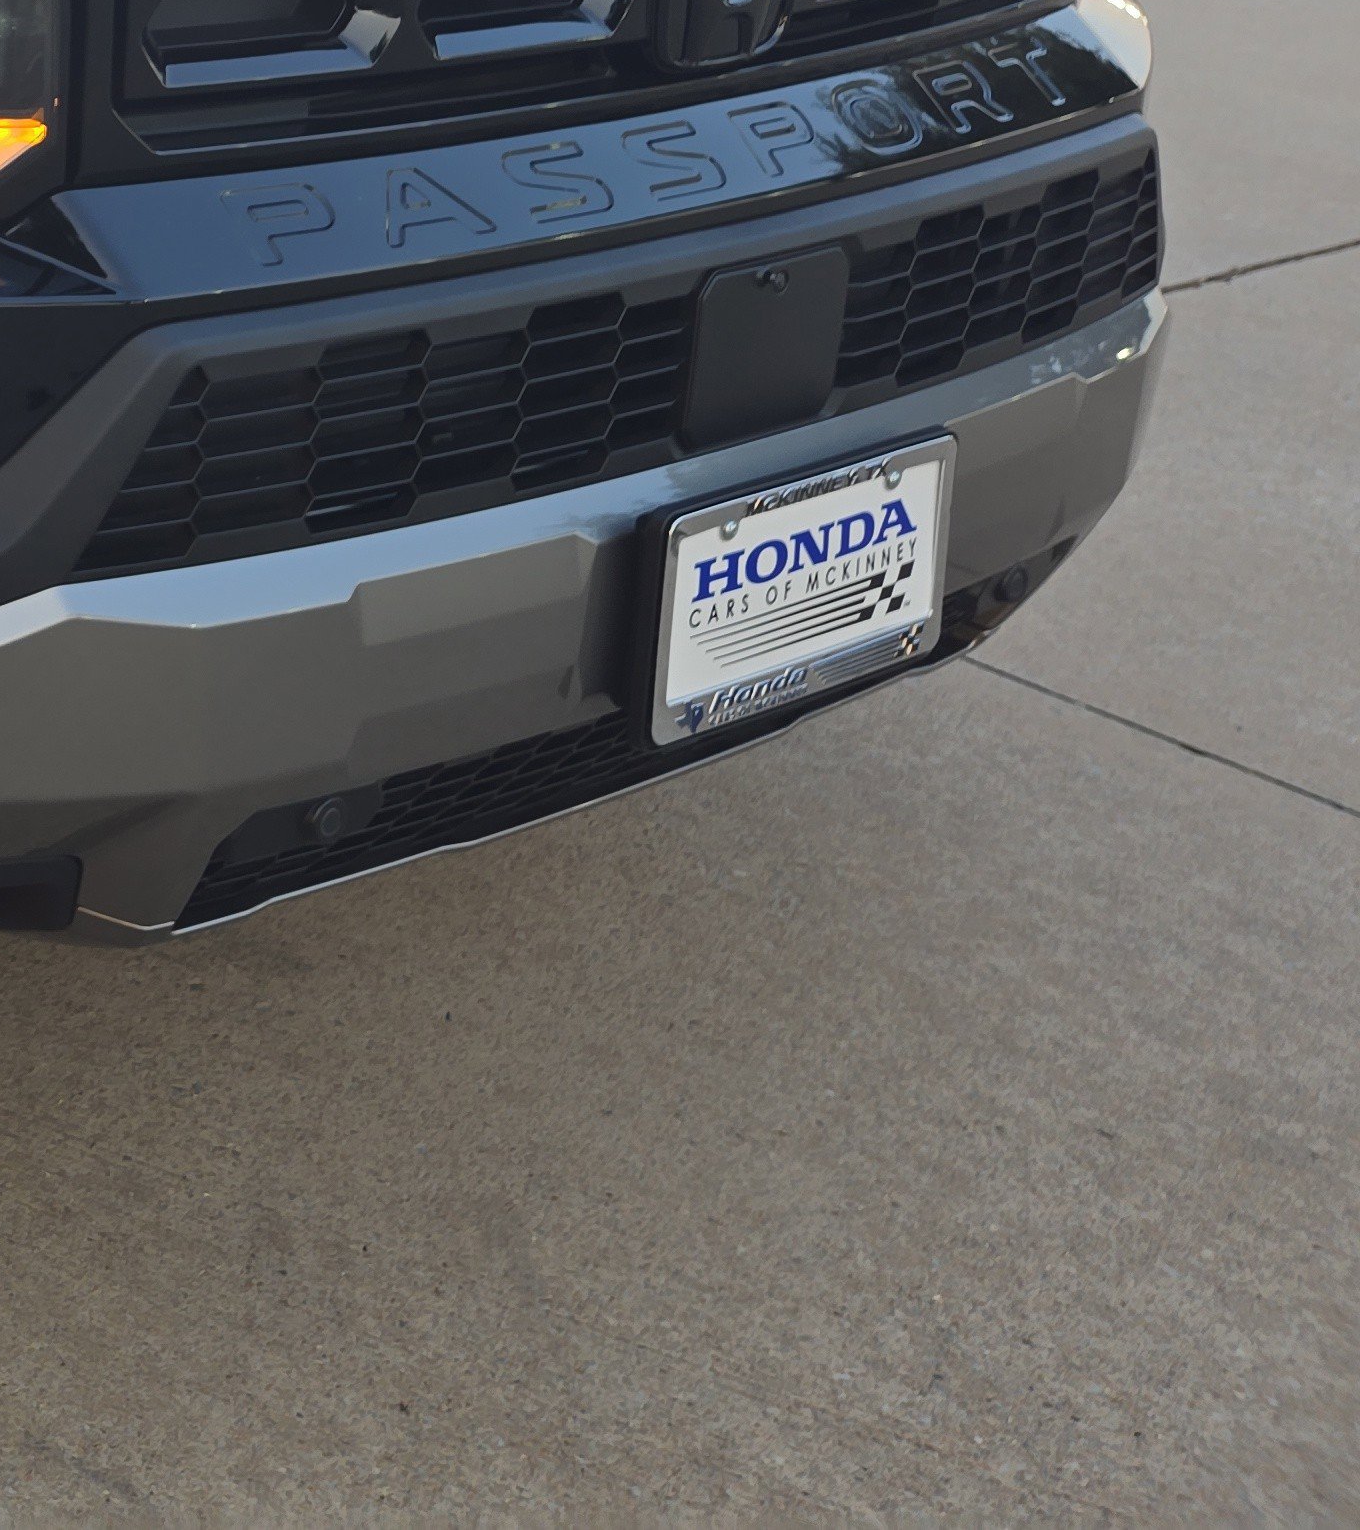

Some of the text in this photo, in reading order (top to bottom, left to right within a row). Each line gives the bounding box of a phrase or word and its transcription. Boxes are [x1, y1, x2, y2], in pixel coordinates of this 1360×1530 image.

[219, 39, 1068, 267] PASSPORT
[689, 537, 917, 628] CARS OF MCKINNEY
[692, 498, 917, 603] HONDA
[708, 666, 809, 714] Honda
